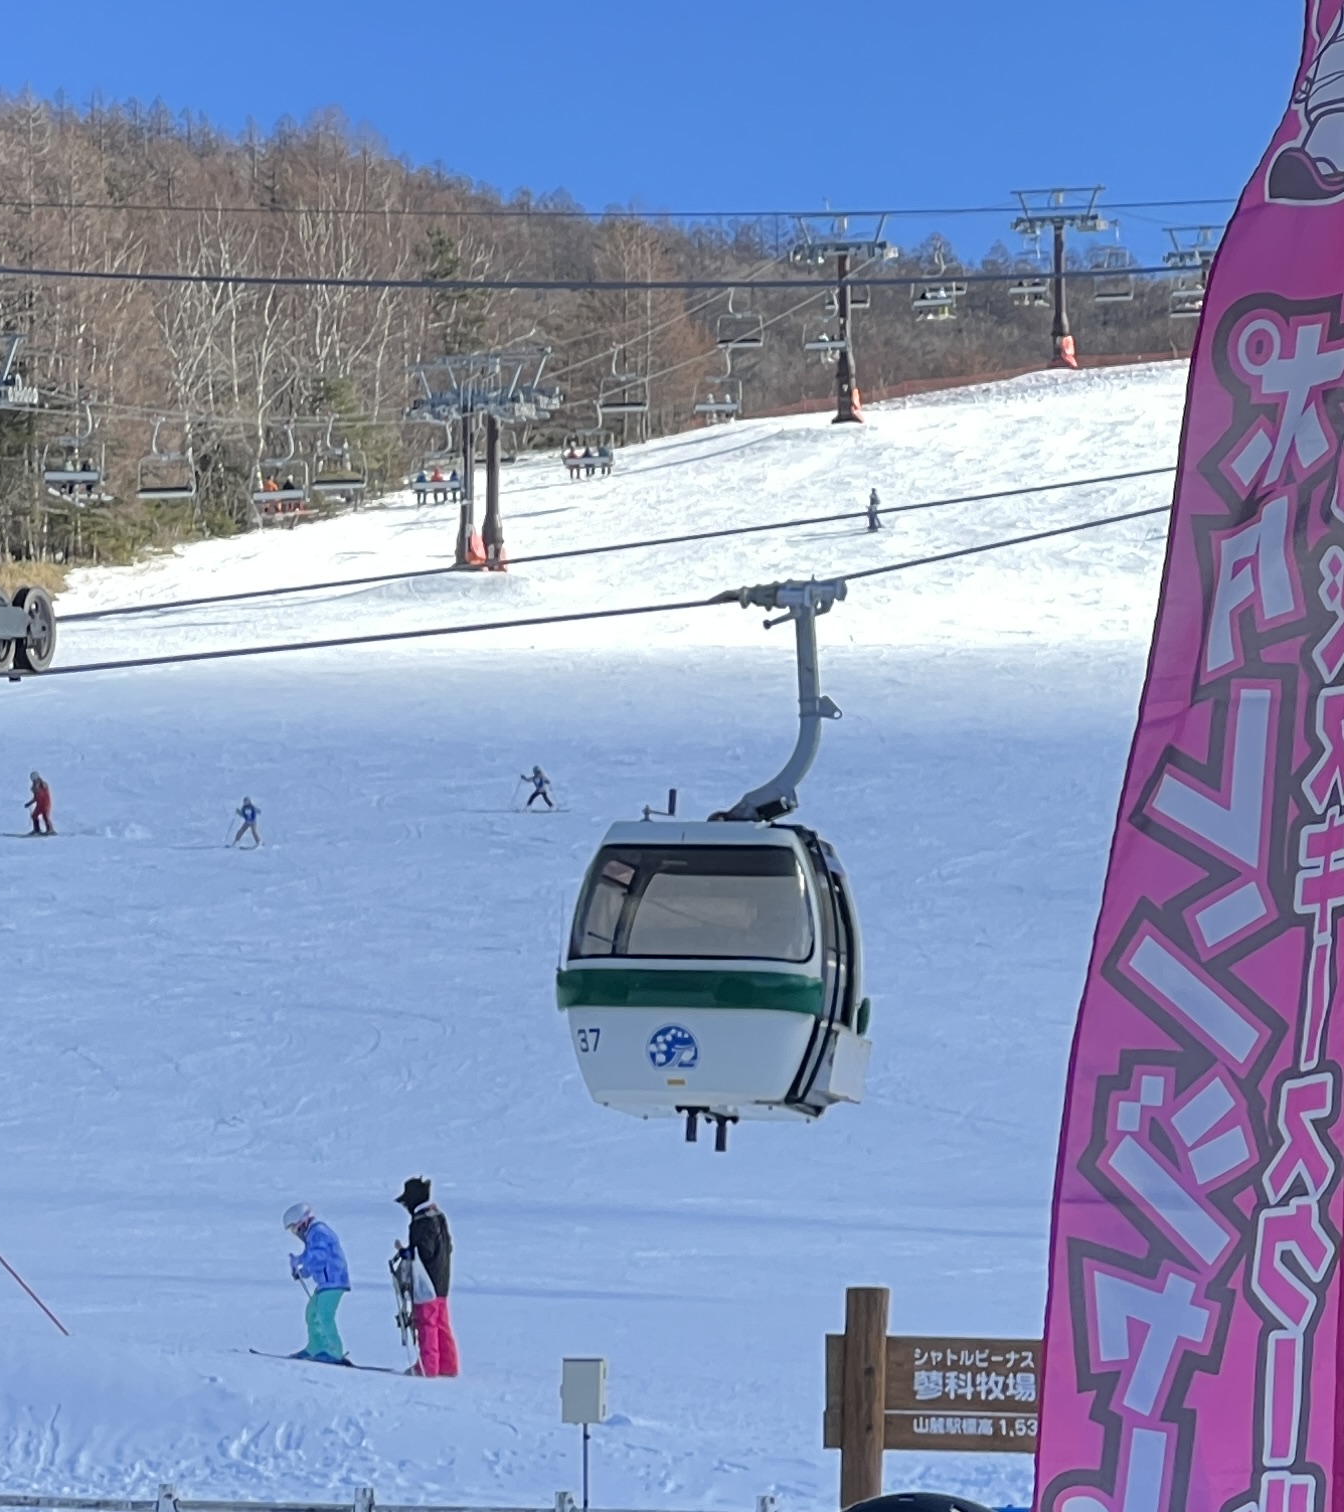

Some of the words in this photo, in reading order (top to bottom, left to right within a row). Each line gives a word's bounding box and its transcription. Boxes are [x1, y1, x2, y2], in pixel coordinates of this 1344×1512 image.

[576, 1028, 602, 1053] 37
[913, 1347, 1035, 1369] シャトルビーナス
[913, 1370, 1037, 1402] 蓼科牧場
